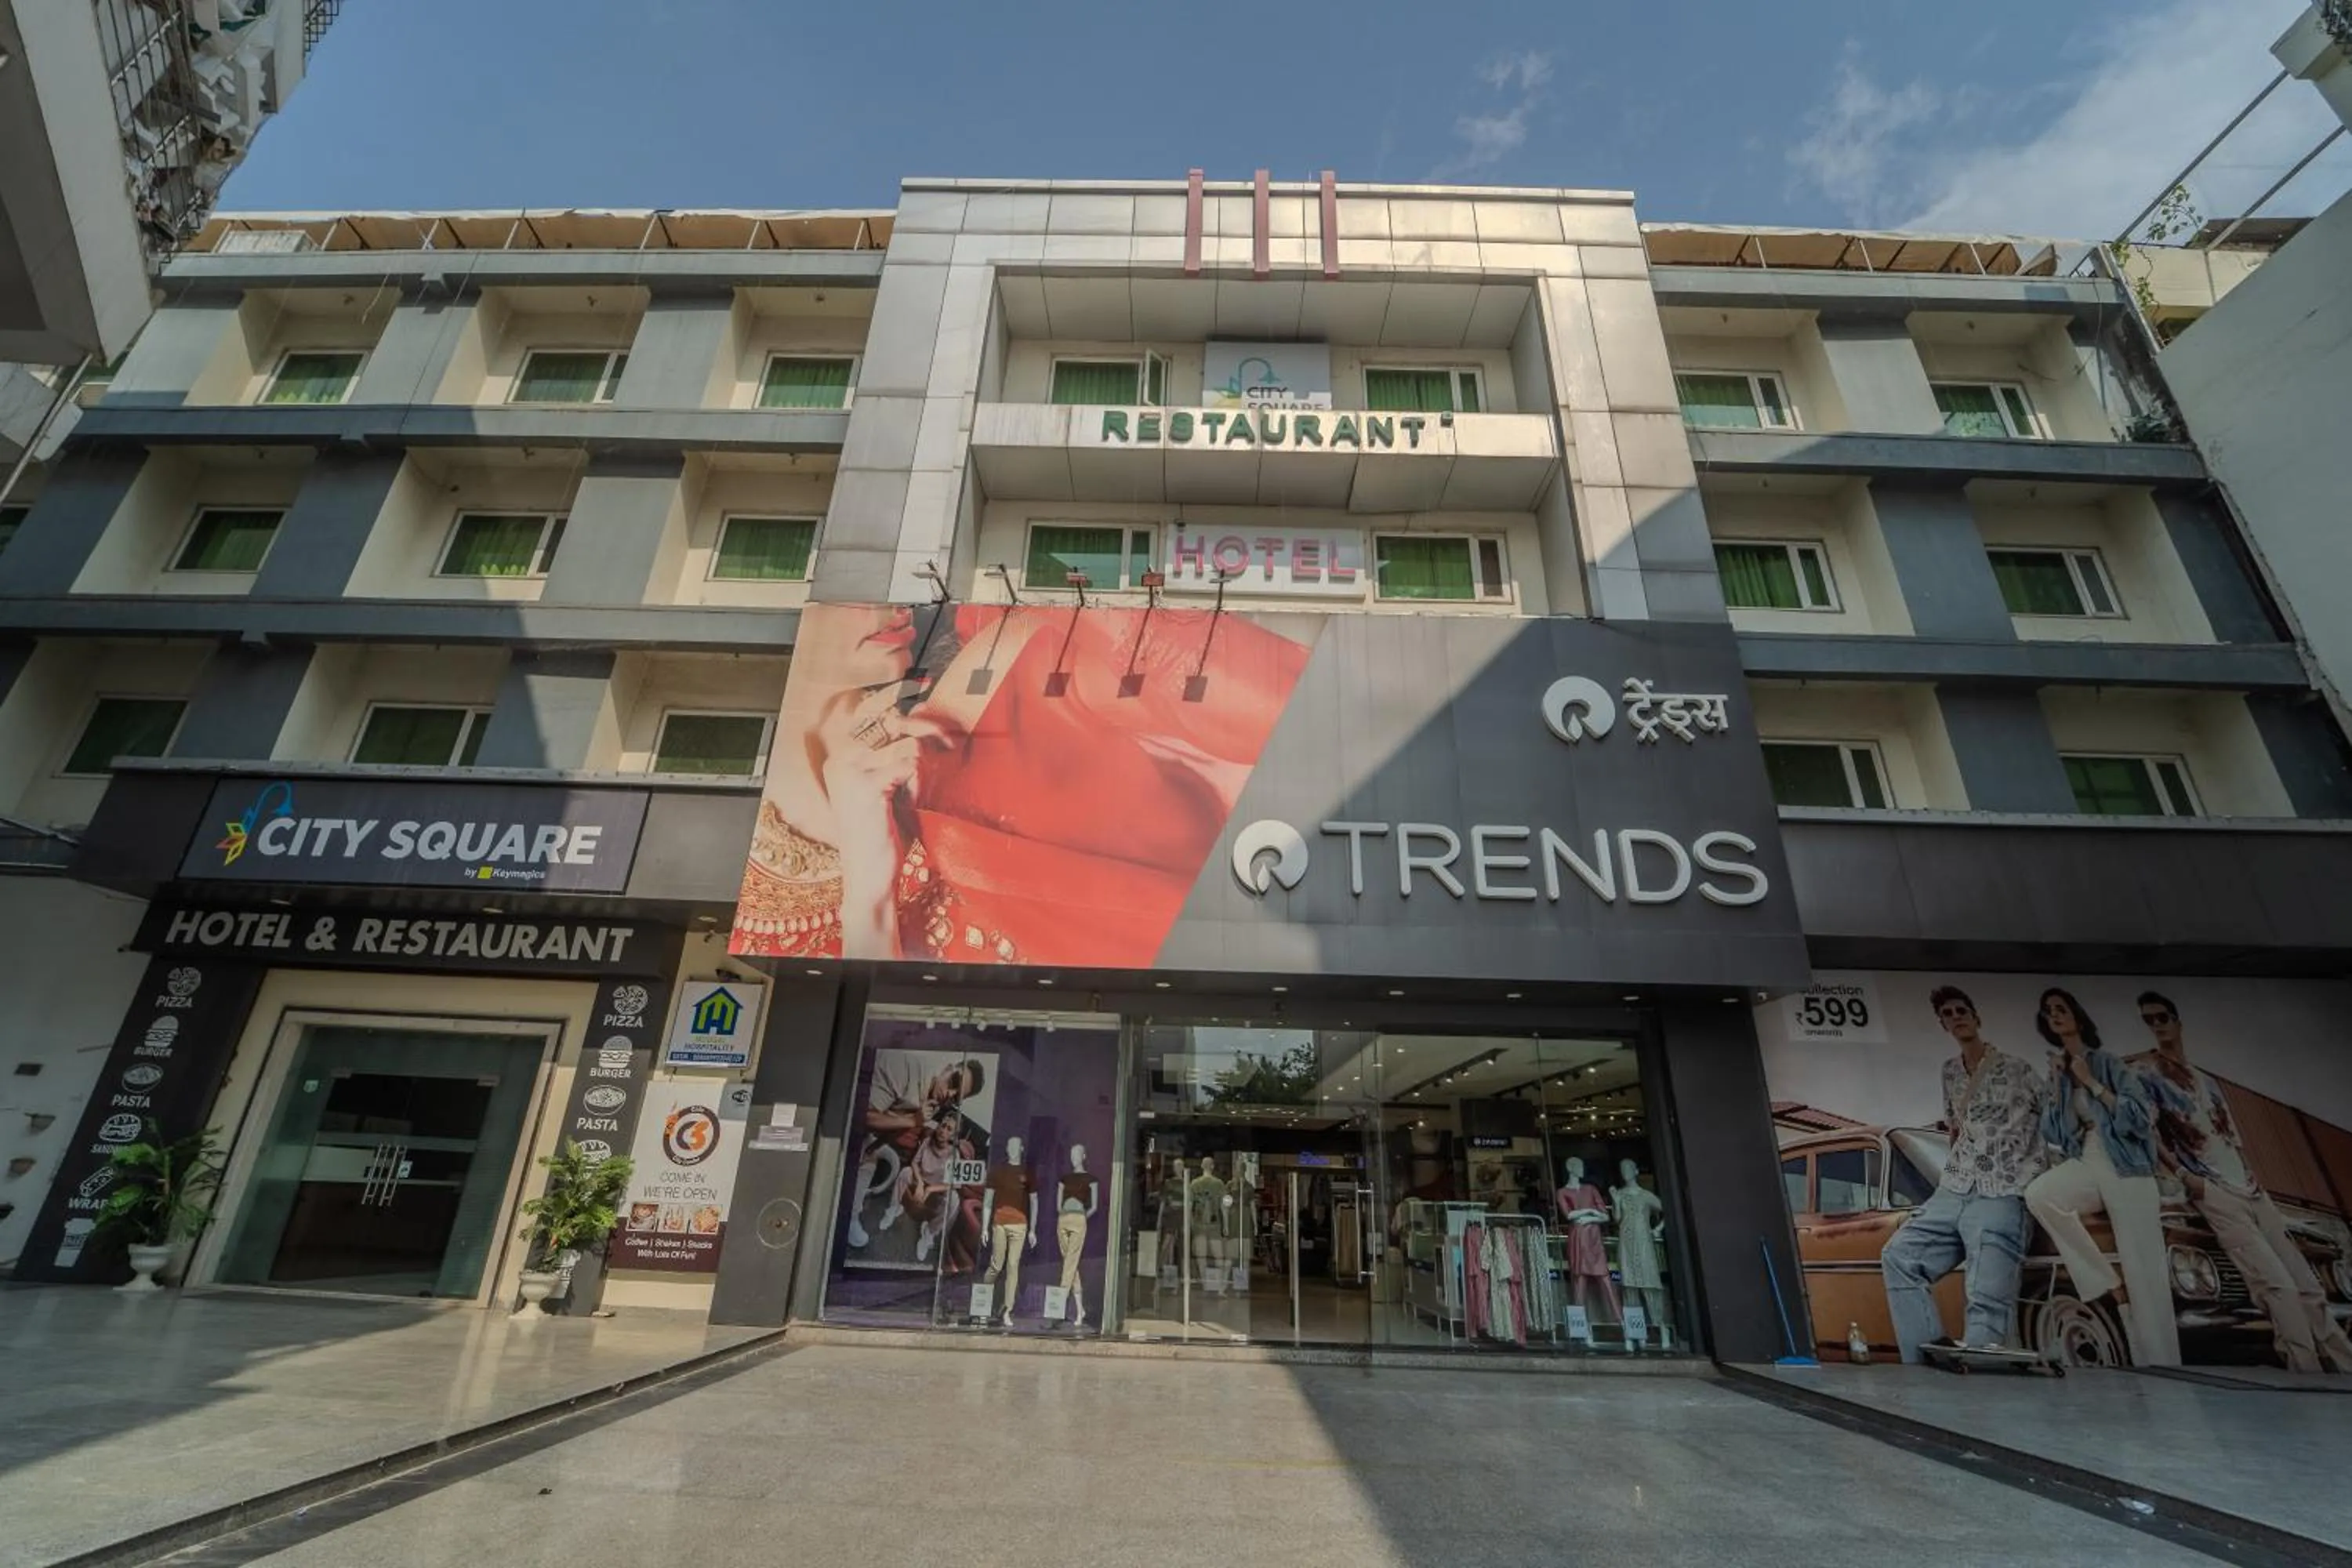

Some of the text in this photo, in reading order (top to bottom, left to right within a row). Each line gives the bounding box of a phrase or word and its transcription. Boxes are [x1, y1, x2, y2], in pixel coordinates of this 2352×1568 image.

[1247, 387, 1287, 399] CITY
[1102, 410, 1425, 448] RESTAURANT
[1173, 535, 1357, 583] HOTEL
[257, 818, 603, 865] CITY SQUARE
[1320, 821, 1769, 906] TRENDS
[464, 867, 477, 878] by
[165, 910, 633, 963] HOTEL & RESTAURANT
[155, 995, 193, 1009] PIZZA
[603, 1014, 644, 1029] PIZZA
[133, 1047, 173, 1058] BURGER
[590, 1067, 631, 1079] BURGER
[112, 1094, 151, 1108] PASTA
[577, 1117, 618, 1131] PASTA
[660, 1172, 706, 1183] COME IN
[684, 1187, 717, 1200] OPEN
